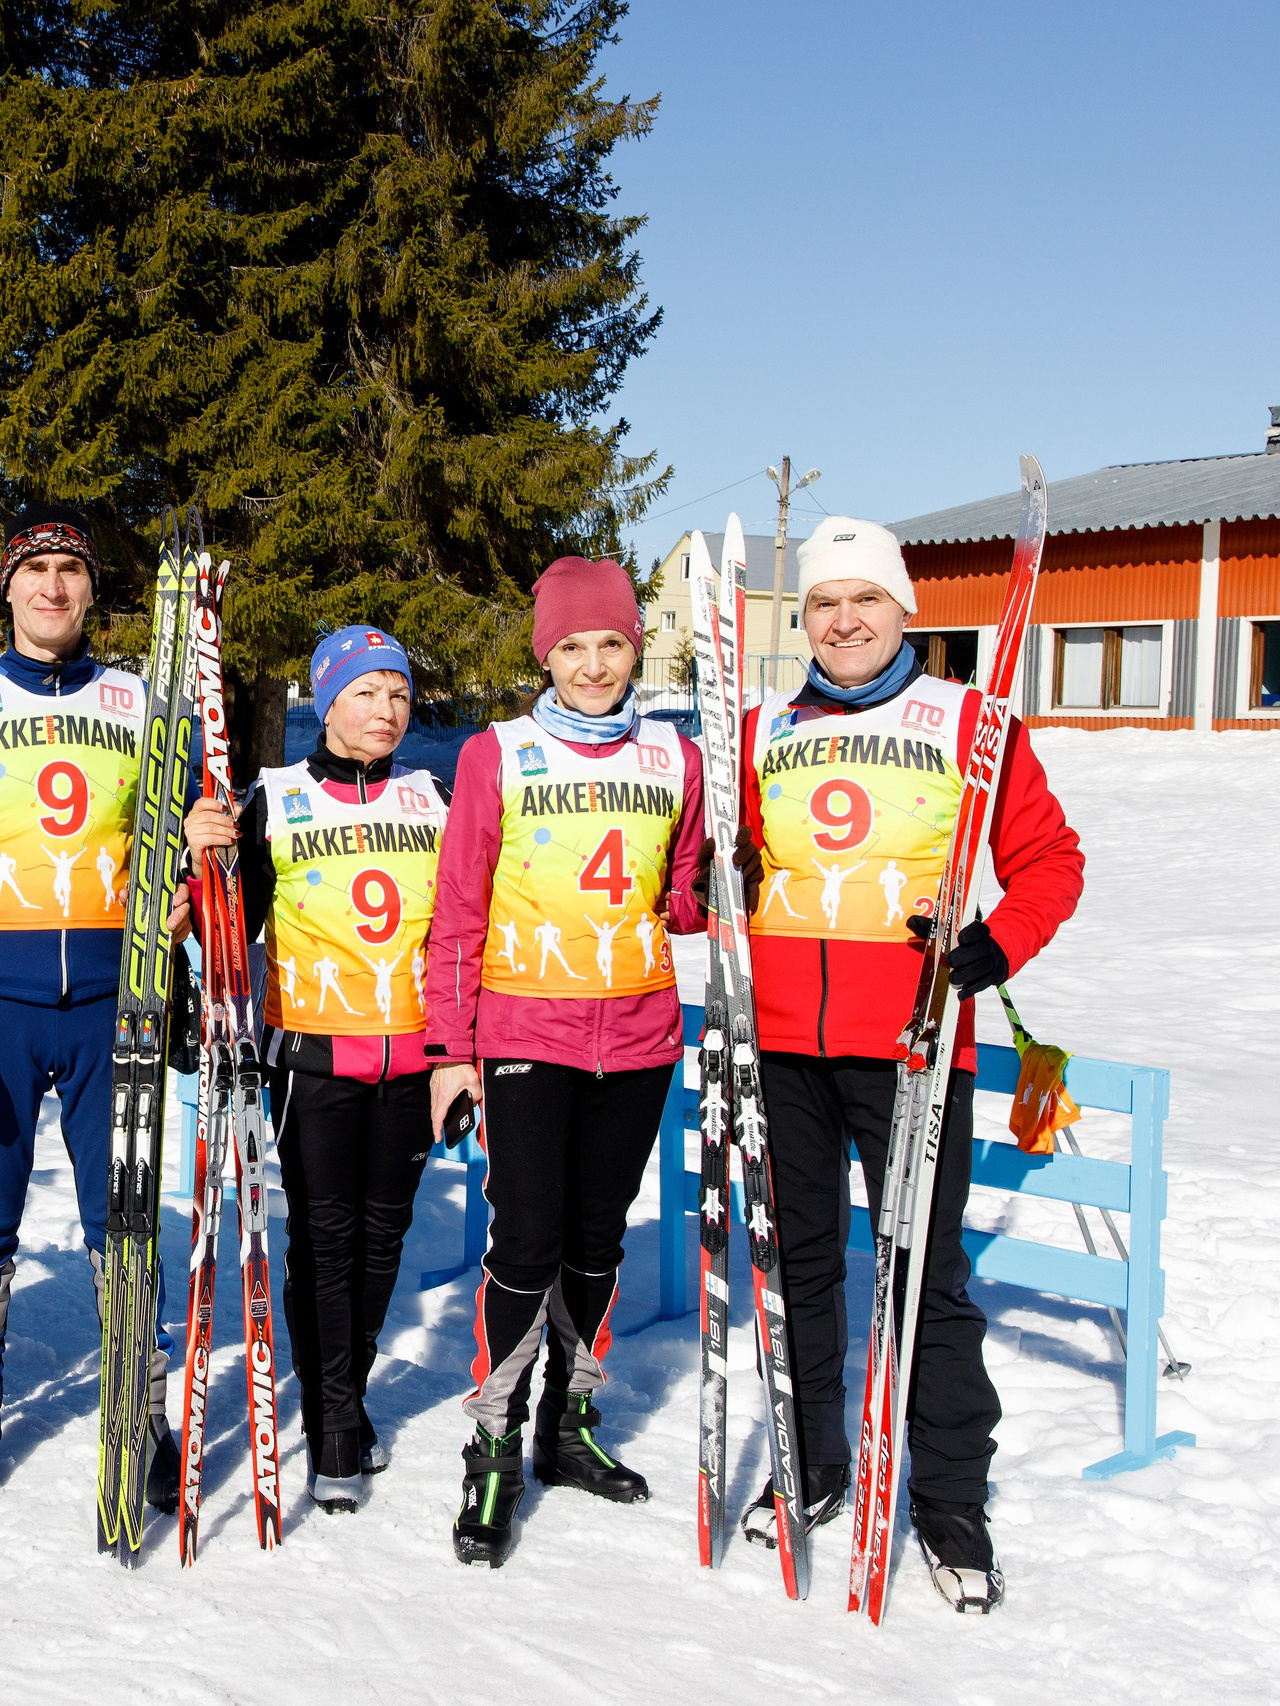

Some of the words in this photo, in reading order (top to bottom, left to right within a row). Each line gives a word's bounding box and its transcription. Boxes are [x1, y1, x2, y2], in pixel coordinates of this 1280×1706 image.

[156, 598, 177, 703] FISCHER
[99, 682, 134, 710] ГТО
[195, 606, 232, 793] ATOMIC
[901, 699, 945, 728] ГТО
[636, 743, 670, 769] ГТО
[761, 735, 946, 780] AKKERMANN
[826, 736, 840, 764] cement
[963, 694, 994, 790] TISA
[976, 696, 1009, 795] TISA
[36, 760, 89, 838] 9
[521, 781, 674, 819] AKKERMANN
[588, 781, 597, 813] cement
[809, 778, 873, 852] 9
[292, 822, 437, 863] AKKERMANN
[353, 824, 365, 854] cement
[578, 827, 633, 907] 4
[226, 876, 241, 971] WORLDCUP
[350, 868, 403, 945] 9
[913, 897, 935, 918] 2
[940, 892, 948, 927] race
[941, 905, 953, 953] SKATING
[659, 942, 671, 972] 3
[197, 1044, 210, 1142] ATOMIC
[924, 1103, 943, 1164] TISA
[709, 1309, 721, 1351] 181
[185, 1346, 209, 1516] ATOMIC
[251, 1340, 279, 1509] ATOMIC
[860, 1419, 870, 1480] cap
[775, 1401, 800, 1524] ACADIA
[879, 1431, 889, 1493] cap
[467, 1484, 478, 1510] TREK
[779, 1503, 791, 1553] SKATING
